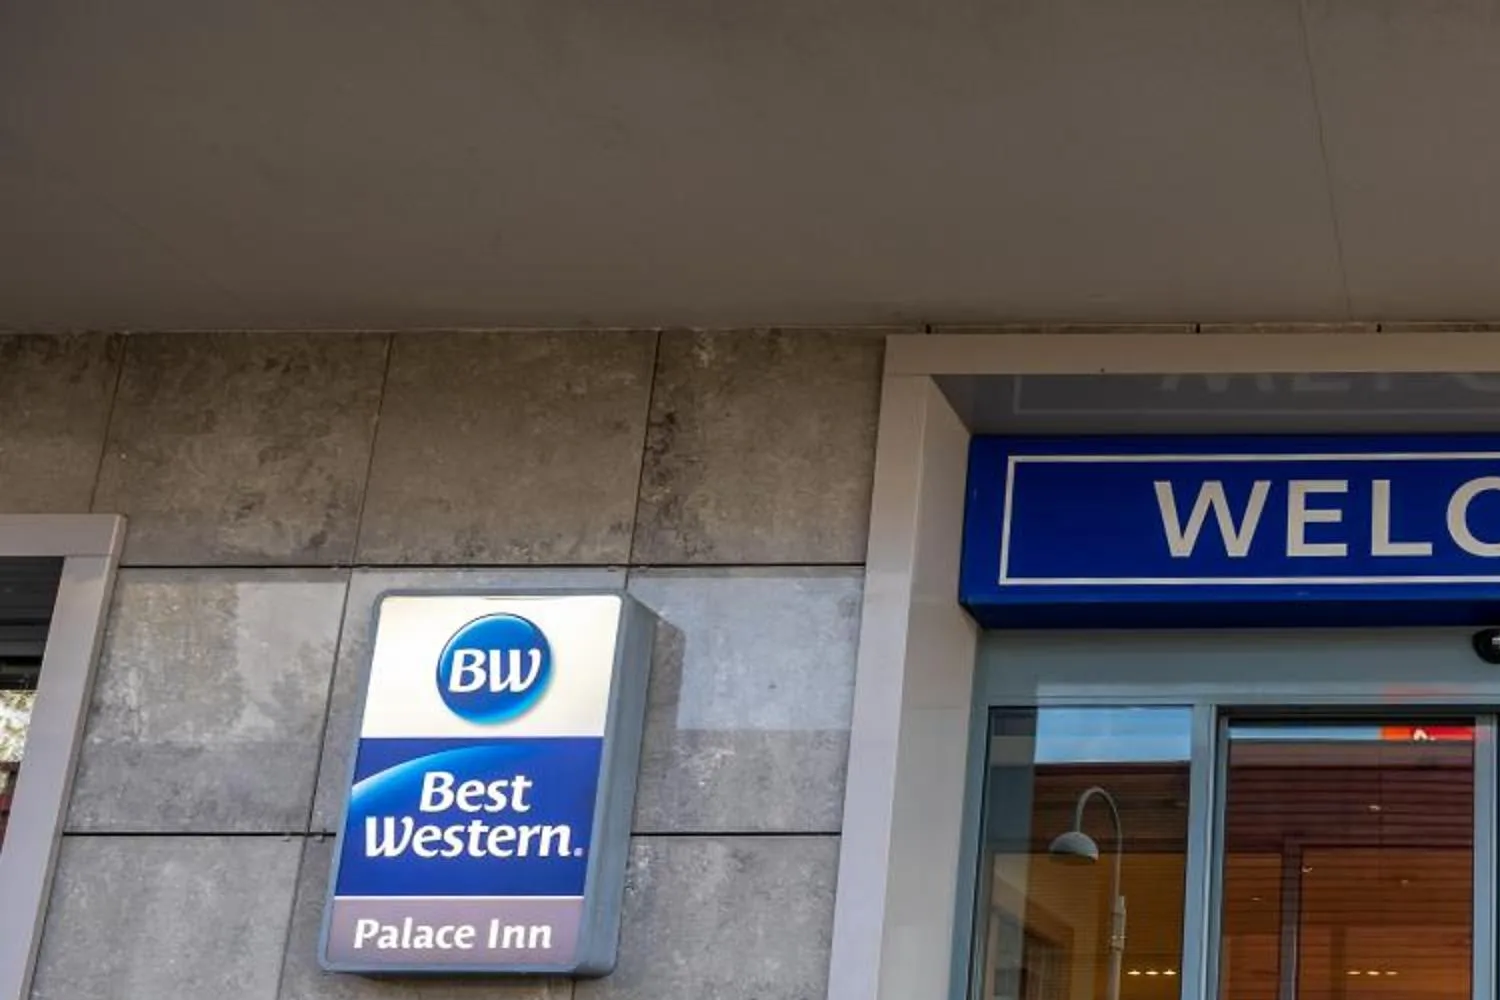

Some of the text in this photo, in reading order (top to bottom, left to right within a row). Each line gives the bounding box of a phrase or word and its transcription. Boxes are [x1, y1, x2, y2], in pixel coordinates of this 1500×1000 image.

[448, 648, 542, 694] BW
[419, 771, 533, 814] Best
[354, 918, 552, 950] Palace Inn
